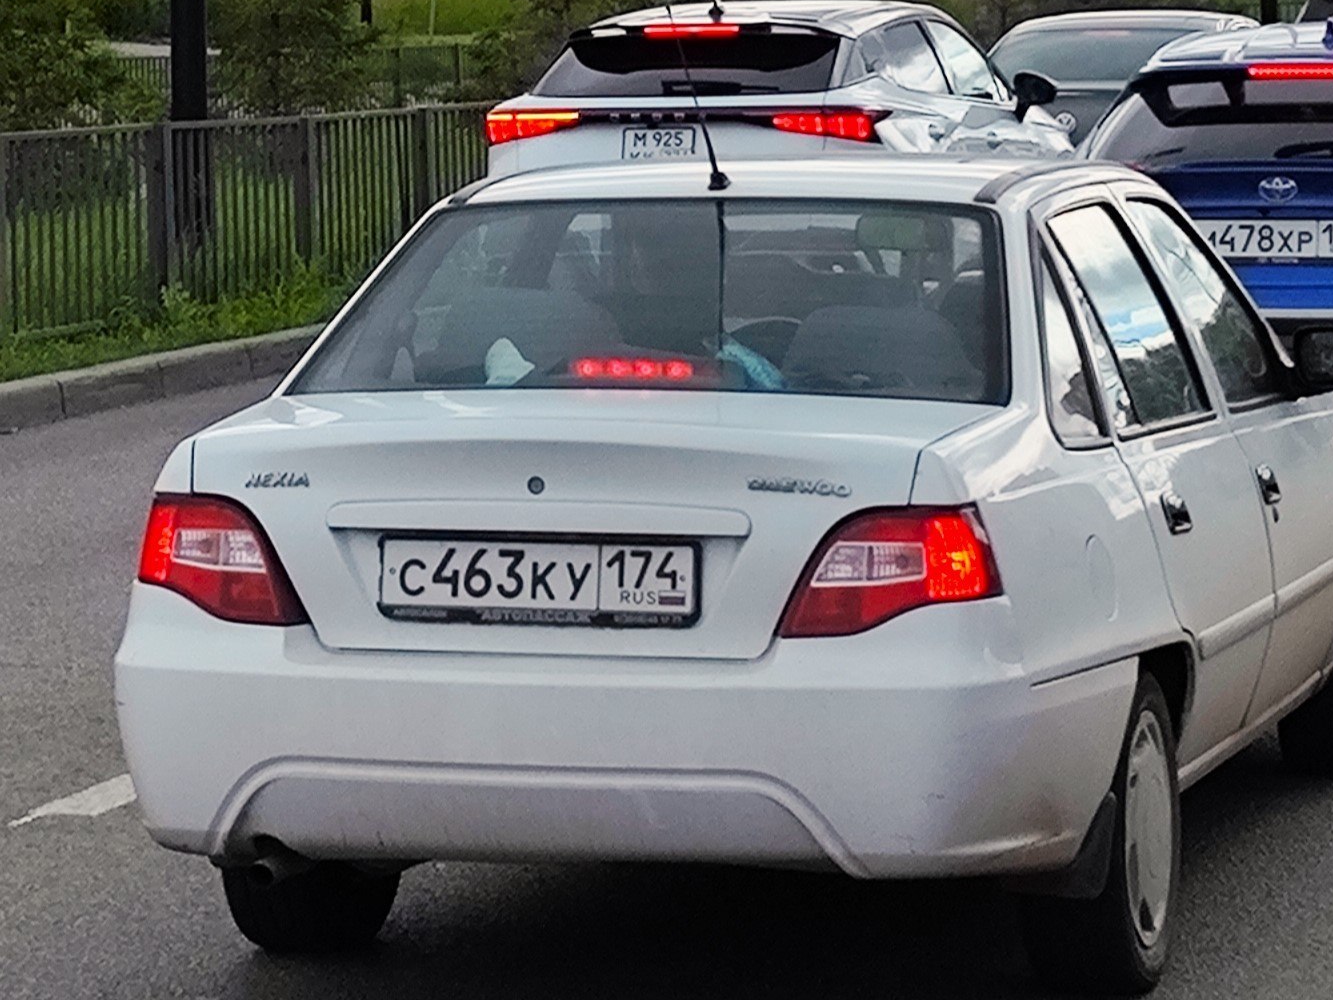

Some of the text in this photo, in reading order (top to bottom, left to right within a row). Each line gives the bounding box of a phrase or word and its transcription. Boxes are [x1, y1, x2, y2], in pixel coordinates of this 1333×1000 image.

[653, 131, 684, 147] 925
[245, 471, 310, 489] NEXIA
[399, 547, 680, 601] С463КУ 174
[619, 590, 656, 605] RUS
